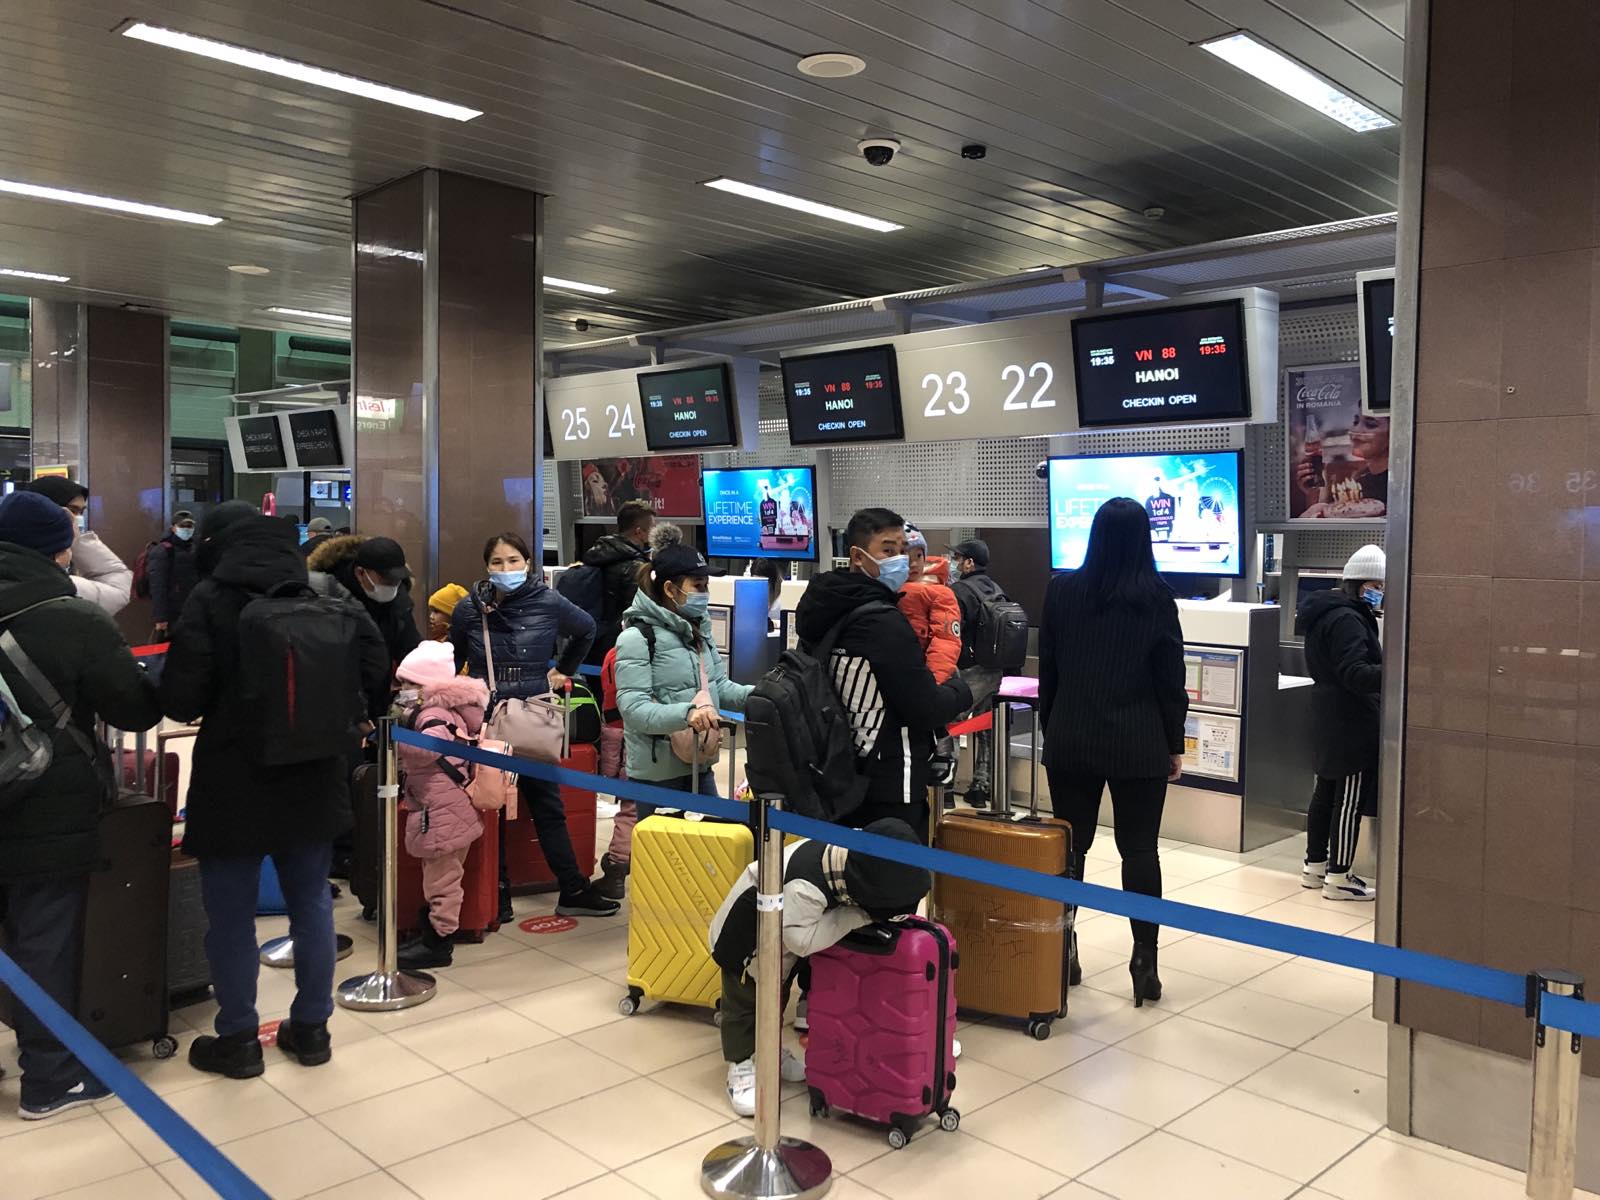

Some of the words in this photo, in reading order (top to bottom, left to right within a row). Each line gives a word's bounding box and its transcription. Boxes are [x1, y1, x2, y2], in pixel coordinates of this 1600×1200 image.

[1135, 349, 1153, 361] VN
[1161, 347, 1176, 359] 88
[1199, 344, 1226, 355] 19:35
[1090, 355, 1115, 366] 19:35
[1135, 368, 1180, 383] HANOI
[824, 383, 836, 393] VN
[841, 382, 851, 391] 88
[920, 371, 971, 417] 23
[1001, 362, 1056, 411] 22
[825, 399, 854, 411] HANOI
[1122, 397, 1165, 408] CHECKIN
[1168, 394, 1197, 405] OPEN
[673, 410, 697, 421] HANOI
[561, 407, 591, 441] 25
[605, 403, 636, 438] 24
[818, 421, 846, 431] CHECKIN
[847, 420, 866, 429] OPEN
[692, 429, 708, 437] OPEN
[707, 501, 753, 515] LIFETIME
[762, 502, 775, 510] WIN
[1150, 498, 1171, 509] WIN
[708, 515, 754, 525] EXPERIENCE
